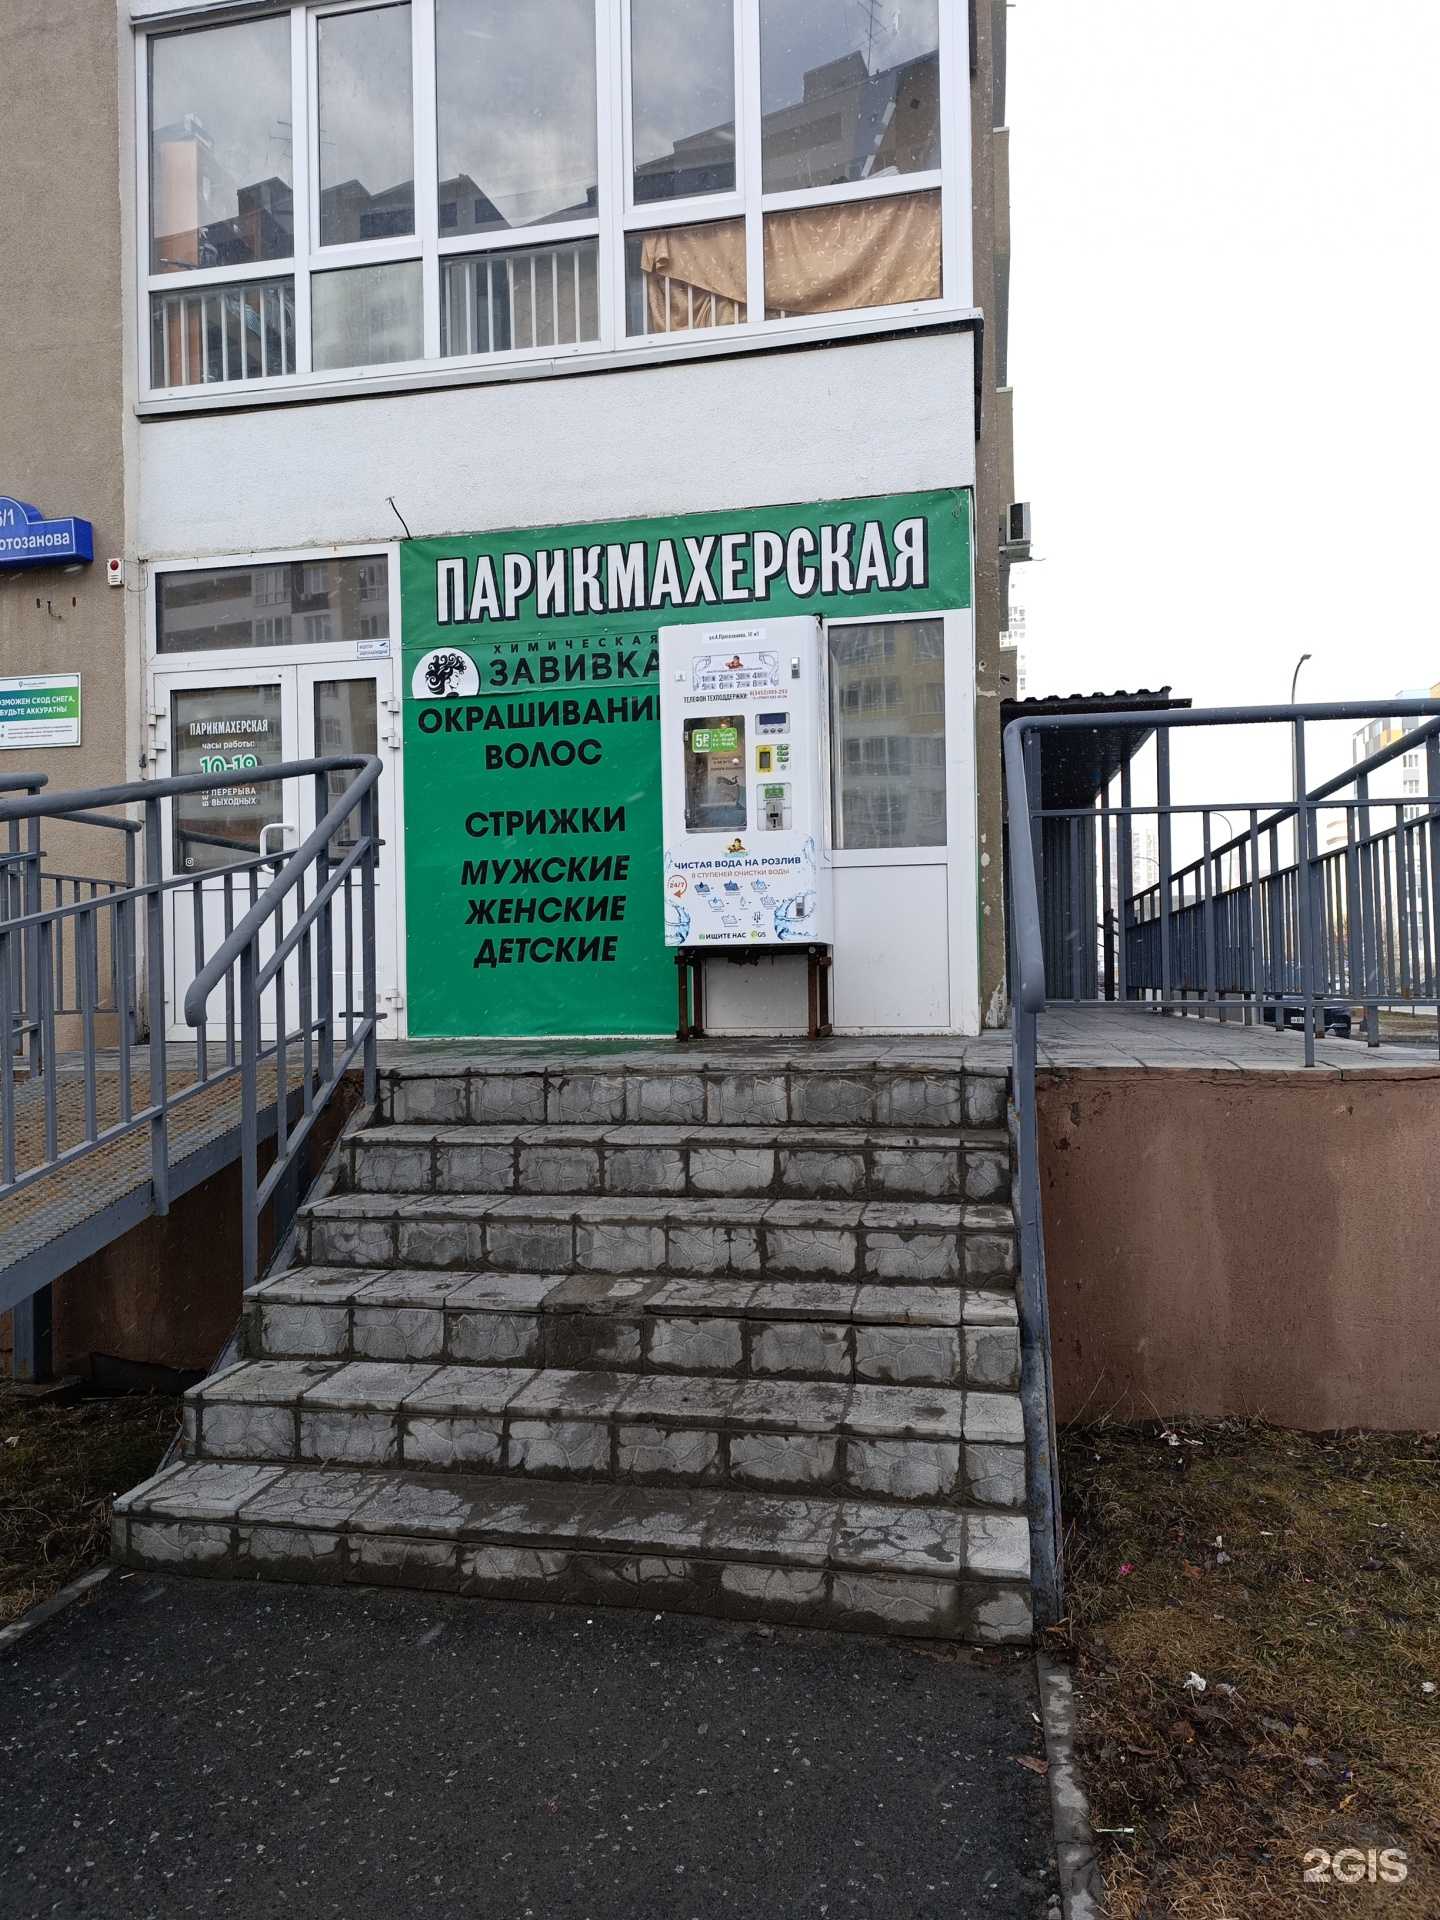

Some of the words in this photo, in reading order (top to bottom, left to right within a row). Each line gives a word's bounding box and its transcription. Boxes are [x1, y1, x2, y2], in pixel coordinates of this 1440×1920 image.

[0, 508, 15, 527] /1
[436, 517, 929, 625] ПАРИКМАХЕРСКАЯ
[494, 634, 658, 655] ХИМИЧЕСКАЯ
[489, 650, 659, 687] ЗАВИВКА
[26, 706, 67, 715] АККУРАТНЫ
[190, 719, 268, 735] ПАРИКМАХЕРСКАЯ
[485, 738, 603, 770] ВОЛОС
[211, 786, 256, 796] ПЕРЕРЫВА
[211, 797, 256, 807] ВЫХОДНЫХ
[465, 806, 626, 837] СТРИЖКИ
[460, 855, 630, 885] МУЖСКИЕ
[674, 860, 712, 870] ЧИСТАЯ
[714, 859, 742, 868] ВОДА
[761, 856, 801, 866] РОЗЛИВ
[464, 895, 627, 925] ЖЕНСКИЕ
[473, 936, 618, 968] ДЕТСКИЕ
